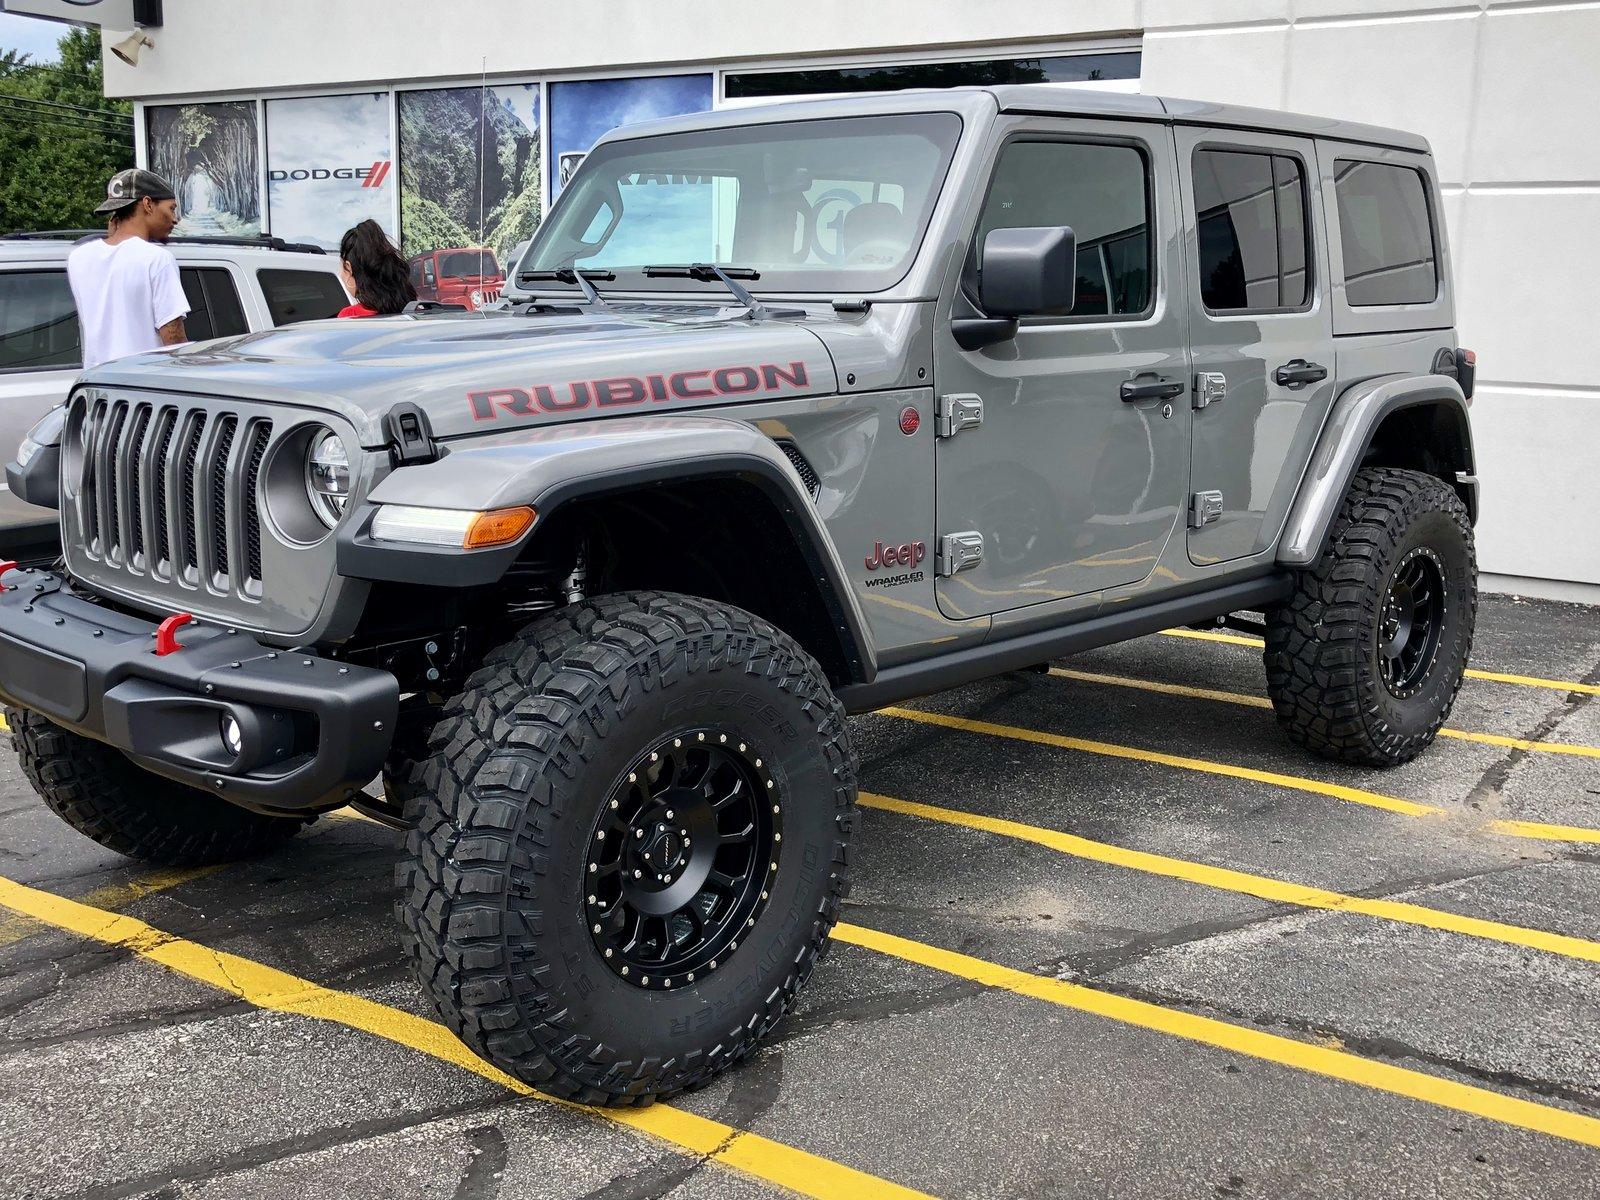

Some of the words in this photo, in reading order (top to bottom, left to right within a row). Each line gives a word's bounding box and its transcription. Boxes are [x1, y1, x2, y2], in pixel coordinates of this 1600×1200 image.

[269, 168, 375, 181] DODGE
[111, 179, 124, 198] C
[466, 361, 810, 422] RUBICON
[864, 541, 926, 570] Jeep
[865, 571, 924, 588] WRANGLER
